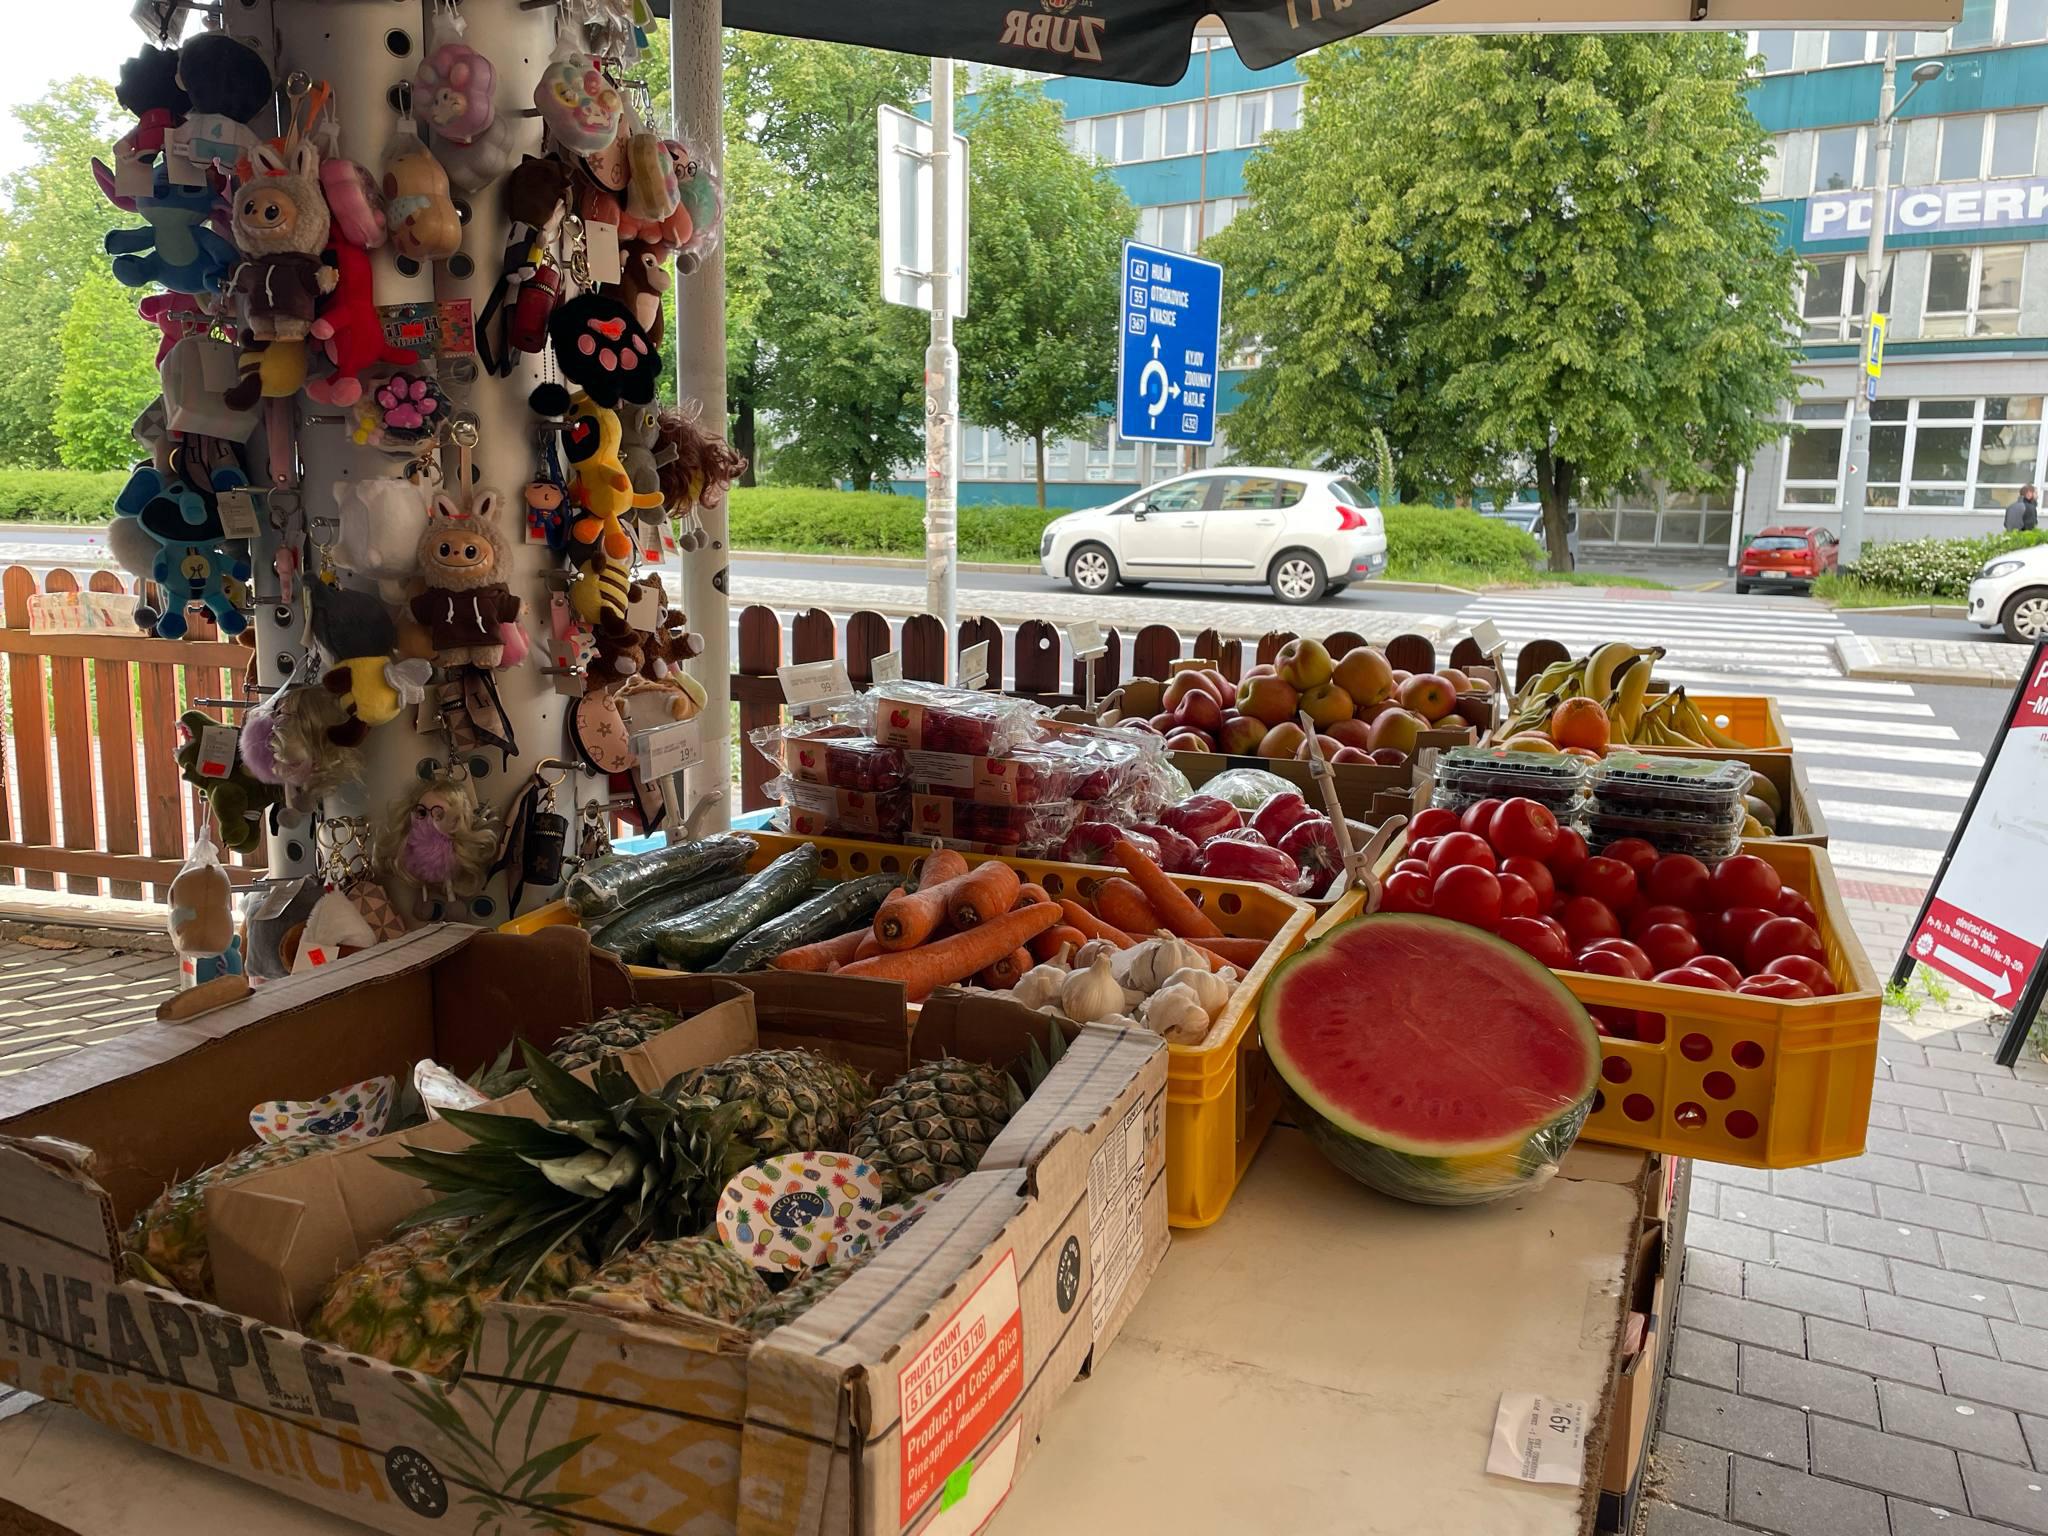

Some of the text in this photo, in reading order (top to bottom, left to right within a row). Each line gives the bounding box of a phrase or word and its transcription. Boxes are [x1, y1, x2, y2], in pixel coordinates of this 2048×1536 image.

[1134, 264, 1145, 277] 47
[1133, 285, 1189, 308] 55 OTROKOVICE
[1131, 306, 1177, 330] 367 KVASICE
[1183, 391, 1206, 408] RATAJE
[820, 682, 832, 693] 99
[680, 748, 690, 762] 19
[773, 1192, 822, 1218] NICO GOLD
[905, 1320, 961, 1393] FRUIT COUNT
[910, 1322, 985, 1415] 5 6 7 8 9 10
[907, 1327, 1018, 1463] Product of Costa Rica
[1548, 1415, 1572, 1434] 49
[907, 1431, 954, 1488] Pineapple
[955, 1391, 988, 1441] (Ananas
[234, 1405, 391, 1503] RICA
[391, 1454, 410, 1470] NICO
[907, 1481, 929, 1511] Class
